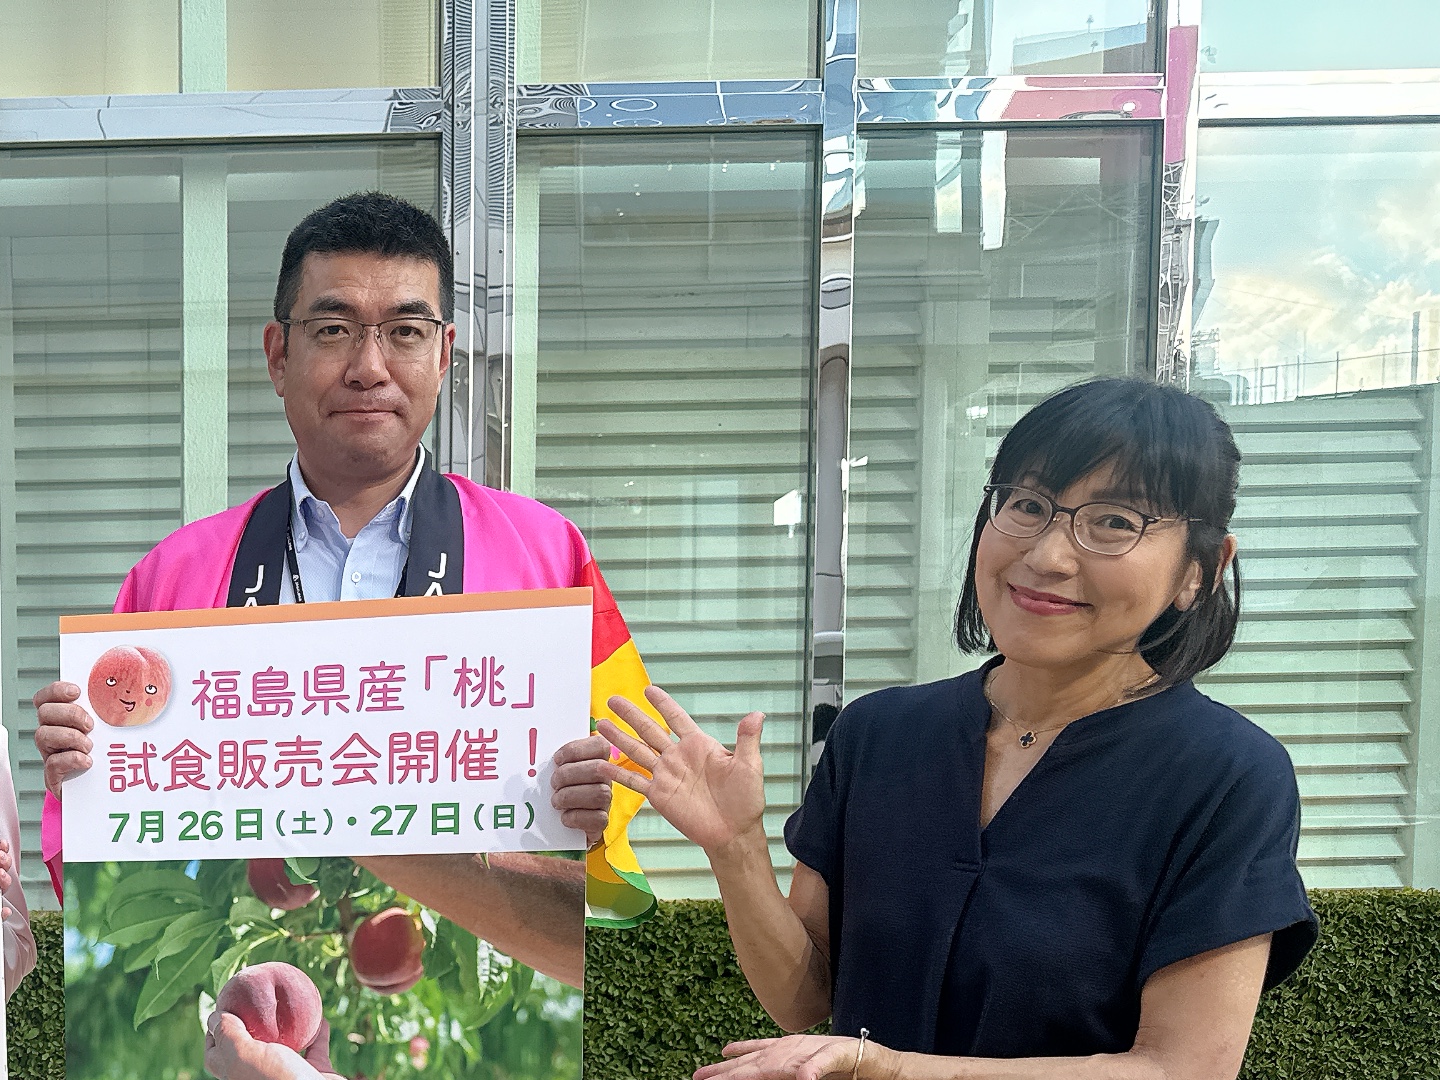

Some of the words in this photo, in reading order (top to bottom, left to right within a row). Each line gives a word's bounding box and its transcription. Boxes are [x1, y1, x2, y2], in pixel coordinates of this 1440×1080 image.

[191, 655, 536, 721] 福島県産「桃」
[107, 727, 539, 794] 試食販売会開催！
